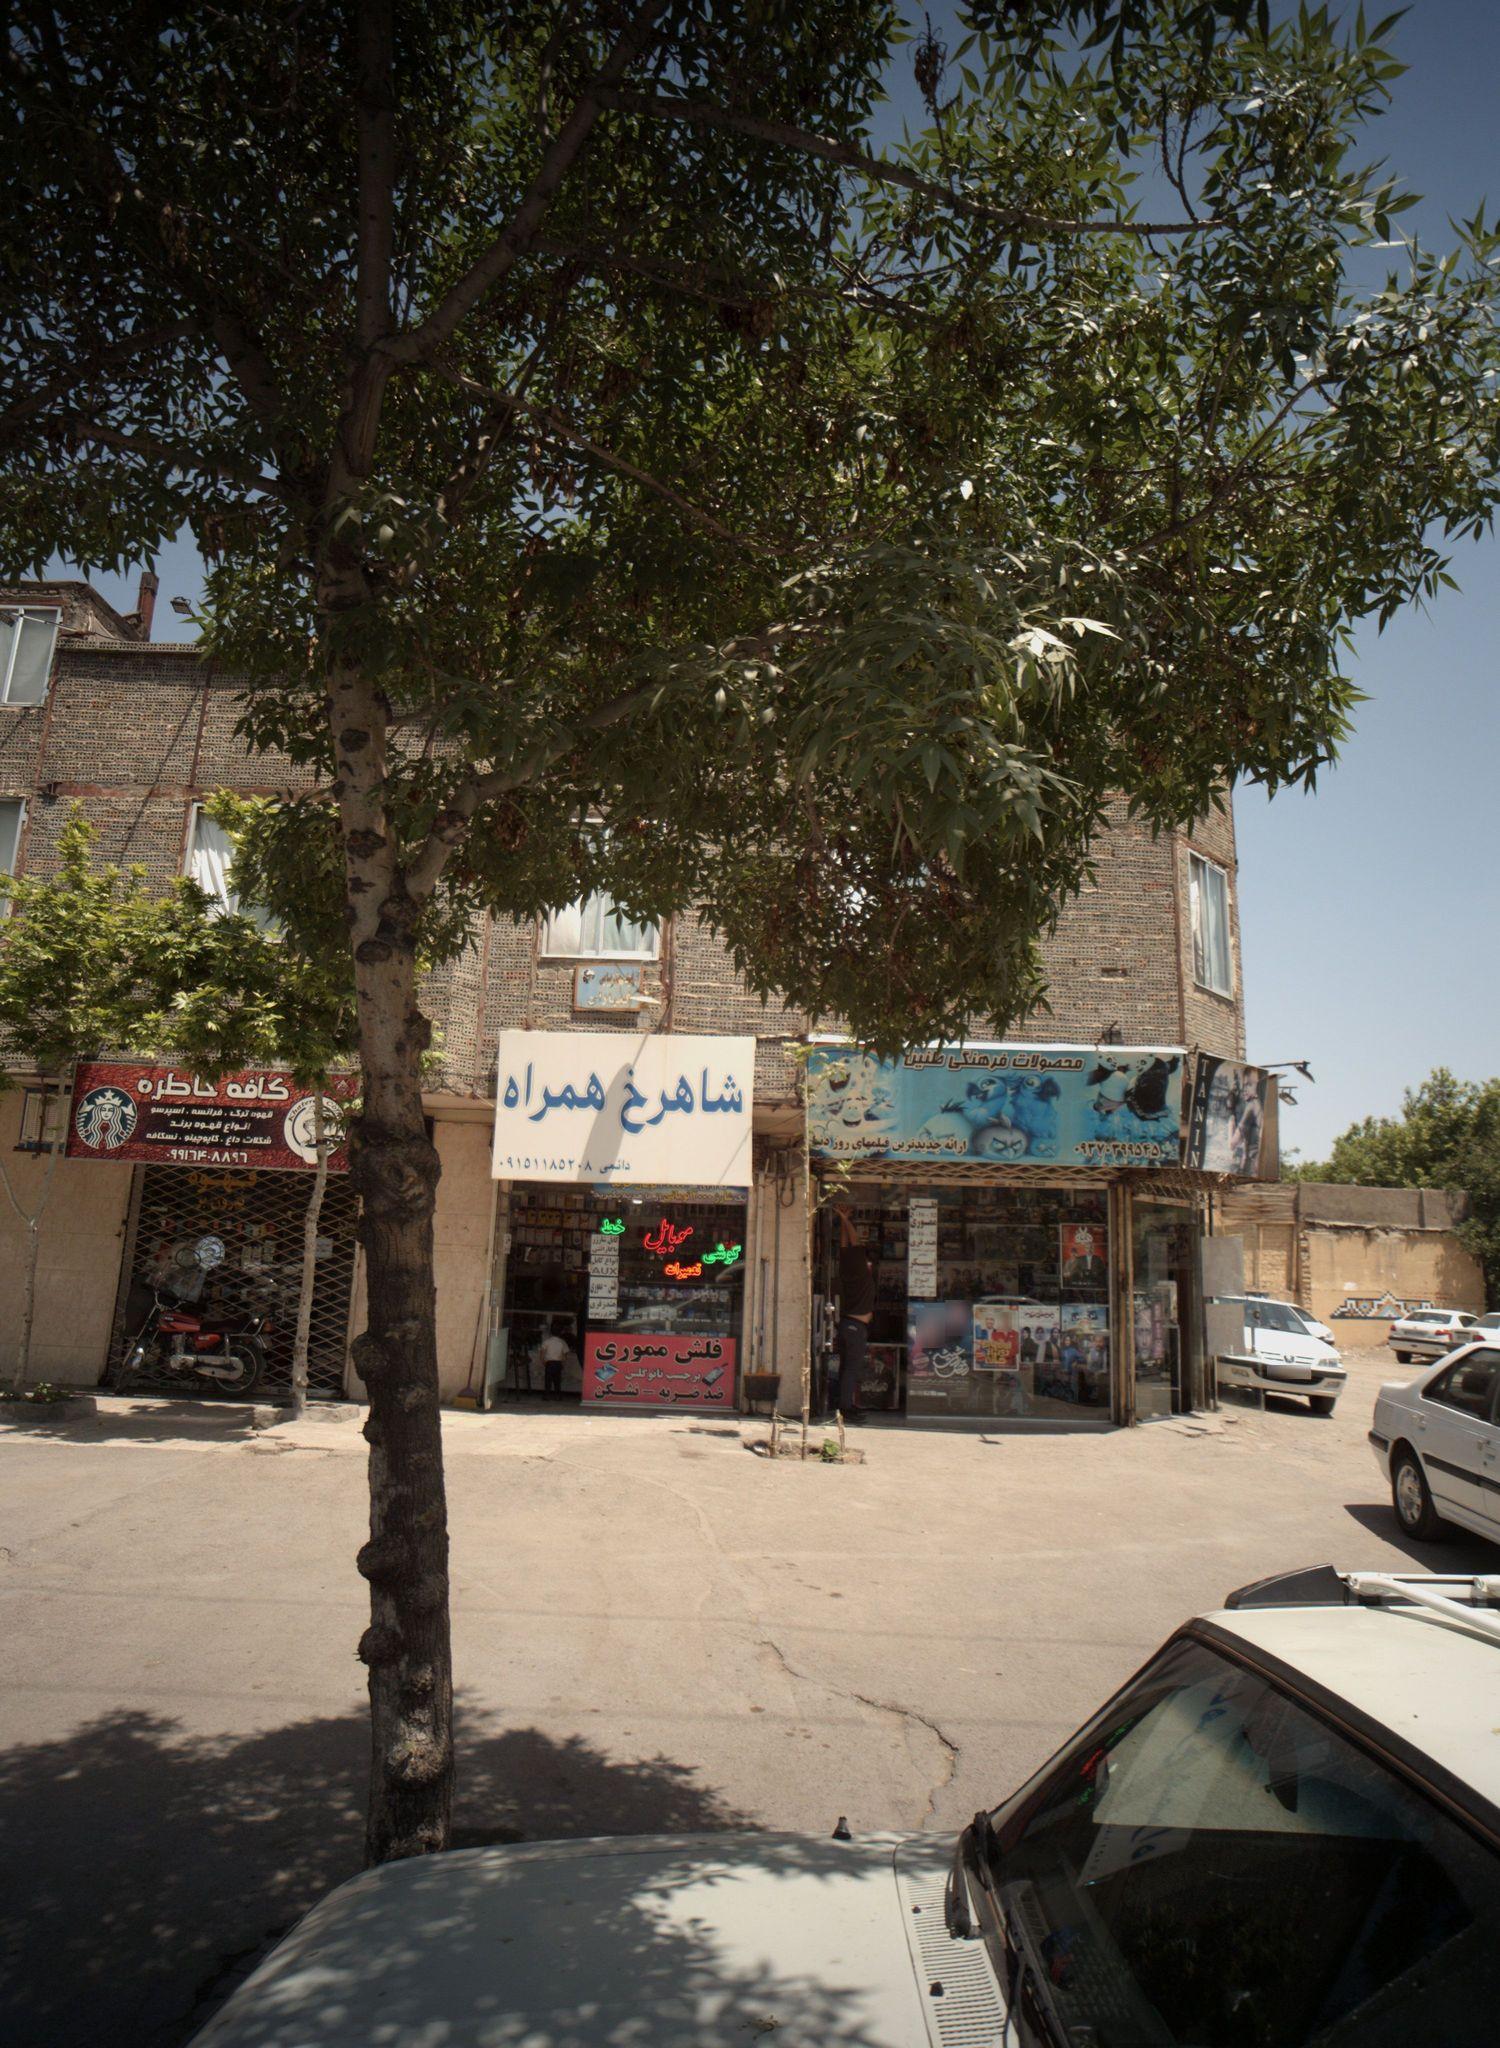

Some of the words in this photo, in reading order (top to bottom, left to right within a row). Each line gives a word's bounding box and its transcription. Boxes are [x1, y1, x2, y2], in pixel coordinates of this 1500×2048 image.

[947, 1050, 1009, 1070] فرهنگی
[1013, 1053, 1084, 1073] محصولات
[226, 1076, 289, 1100] کافه
[503, 1061, 606, 1122] همراه
[620, 1065, 743, 1134] شاهرخ
[151, 1106, 184, 1117] اسپرسو
[191, 1107, 222, 1117] فرانسه
[230, 1109, 249, 1118] ترک
[250, 1110, 273, 1119] قهوه
[1189, 1059, 1209, 1168] TANIN
[194, 1121, 222, 1130] قهوه
[223, 1122, 251, 1133] انواع
[146, 1132, 178, 1141] نسکافه
[225, 1136, 240, 1146] داغ
[242, 1135, 272, 1145] شکلات
[832, 1137, 850, 1151] روز
[601, 1217, 625, 1235] خط
[643, 1218, 694, 1255] موبایل
[702, 1242, 742, 1265] گوشی
[592, 1267, 618, 1275] AUX
[664, 1261, 702, 1279] تعمیرات
[595, 1342, 668, 1362] مموری
[675, 1339, 723, 1364] فلش
[594, 1383, 639, 1399] نشکن
[703, 1387, 724, 1400] ضد
